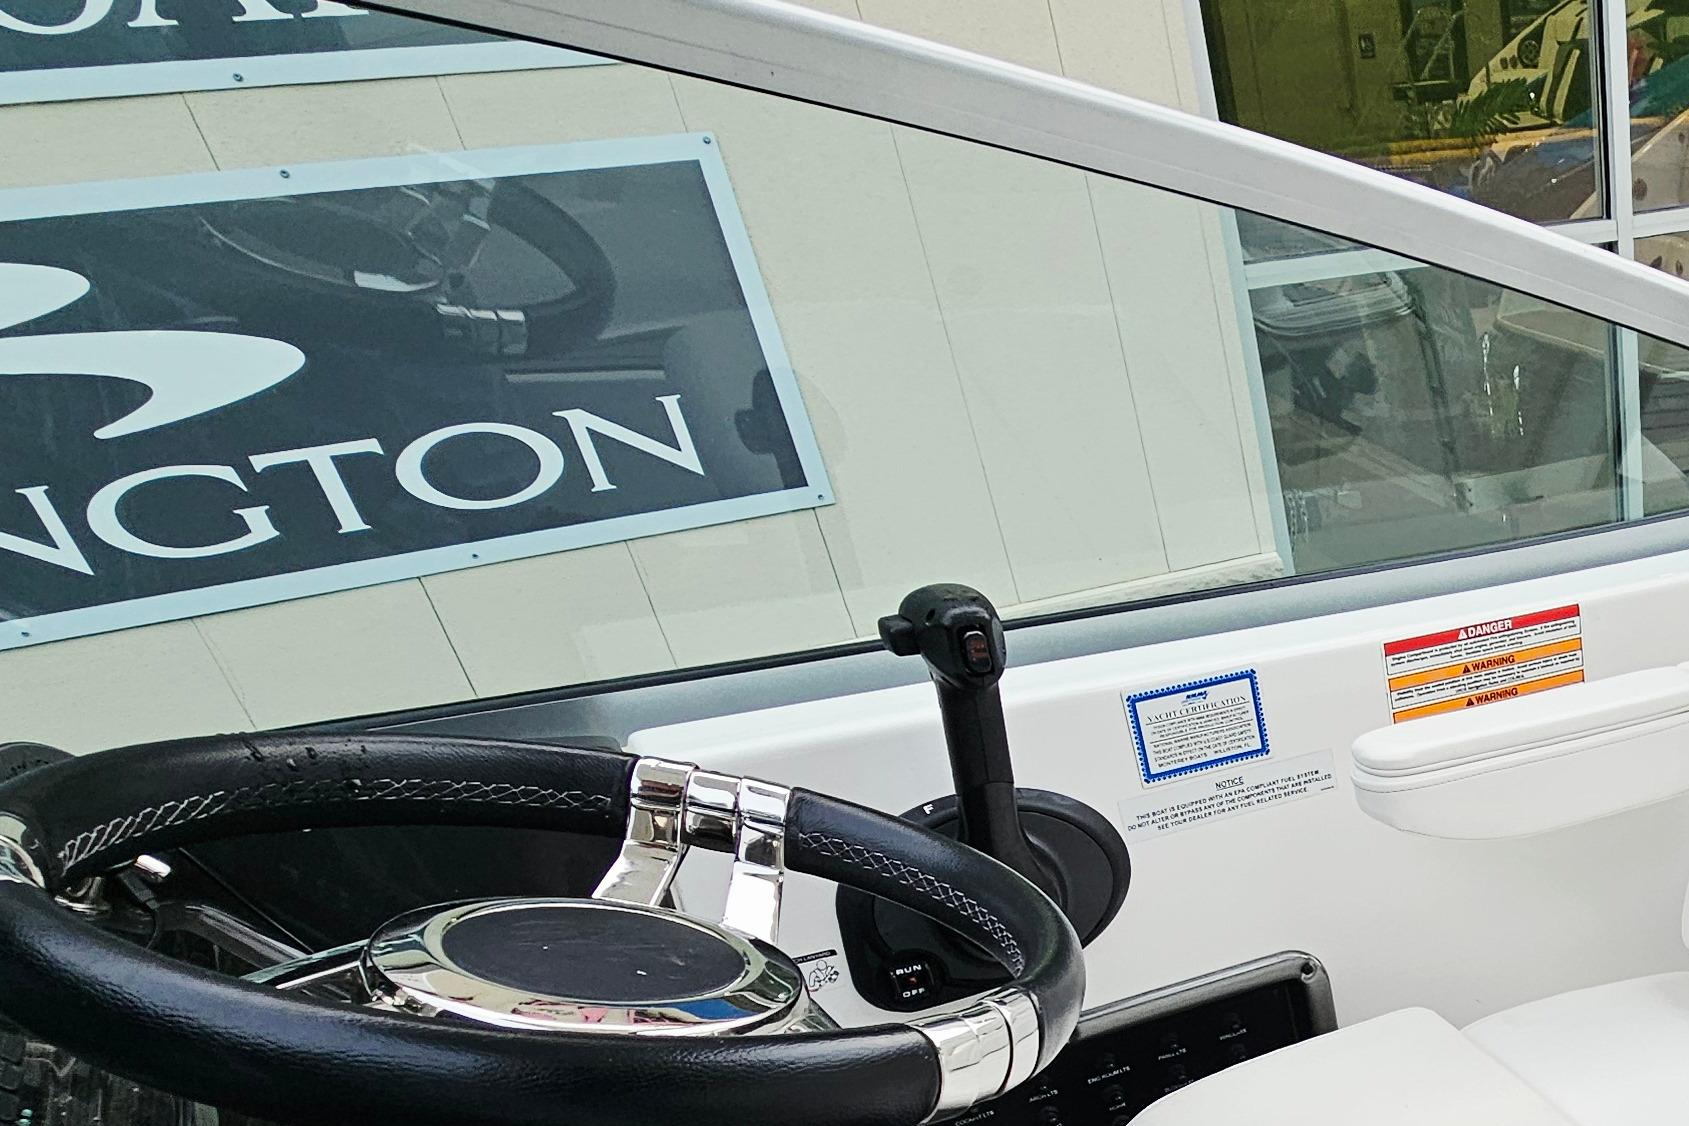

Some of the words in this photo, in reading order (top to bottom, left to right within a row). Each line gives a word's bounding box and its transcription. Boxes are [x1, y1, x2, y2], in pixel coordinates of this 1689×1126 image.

[1467, 619, 1513, 638] DANGER
[1471, 654, 1516, 671] WARNING
[1475, 687, 1518, 704] WARNING
[1147, 711, 1176, 721] YACHT
[1179, 695, 1245, 714] CERTIFICATION
[1215, 776, 1243, 789] NOTICE
[1152, 808, 1166, 816] BOAT
[1177, 798, 1206, 809] EQUIPPED
[1247, 779, 1278, 791] COMPLIANT
[1281, 775, 1294, 783] FUEL
[1297, 769, 1318, 778] SYSTEM
[1151, 816, 1168, 824] ALTER
[1180, 807, 1202, 816] BYPASS
[1237, 788, 1274, 801] COMPONENTS
[1171, 818, 1186, 826] YOUR
[1189, 812, 1211, 821] DEALER
[1257, 794, 1281, 804] RELATED
[895, 964, 922, 976] RUN
[902, 987, 925, 998] OFF
